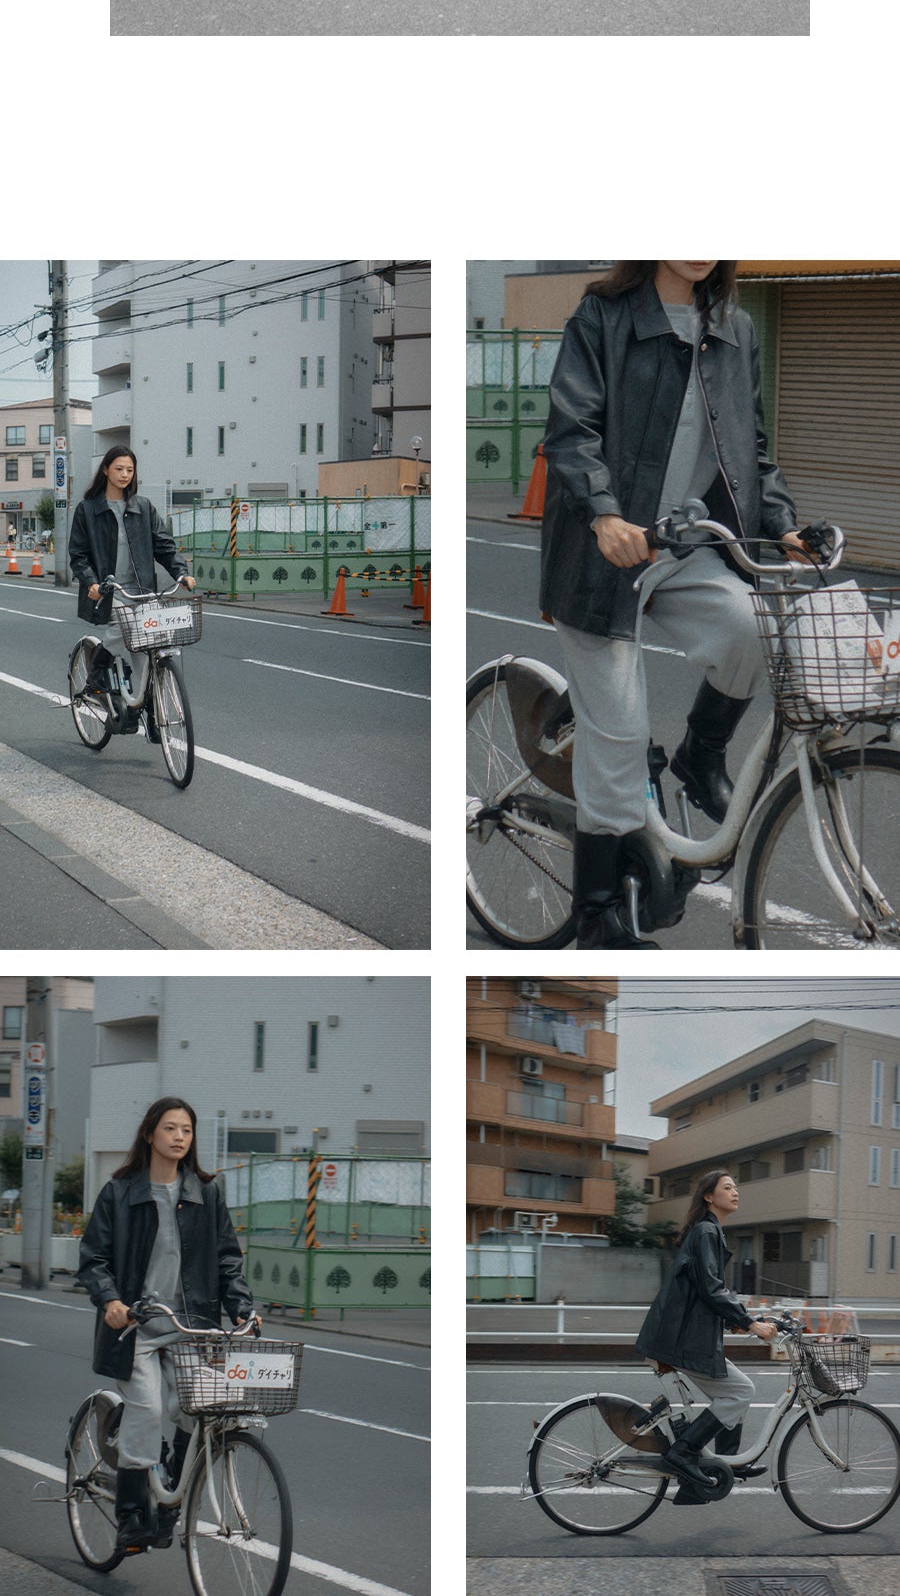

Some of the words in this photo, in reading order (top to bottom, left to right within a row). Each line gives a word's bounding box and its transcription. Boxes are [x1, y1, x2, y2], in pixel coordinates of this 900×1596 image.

[165, 615, 191, 625] ダイチャリ
[227, 1360, 254, 1380] dai
[257, 1368, 292, 1381] ダイチャリ
